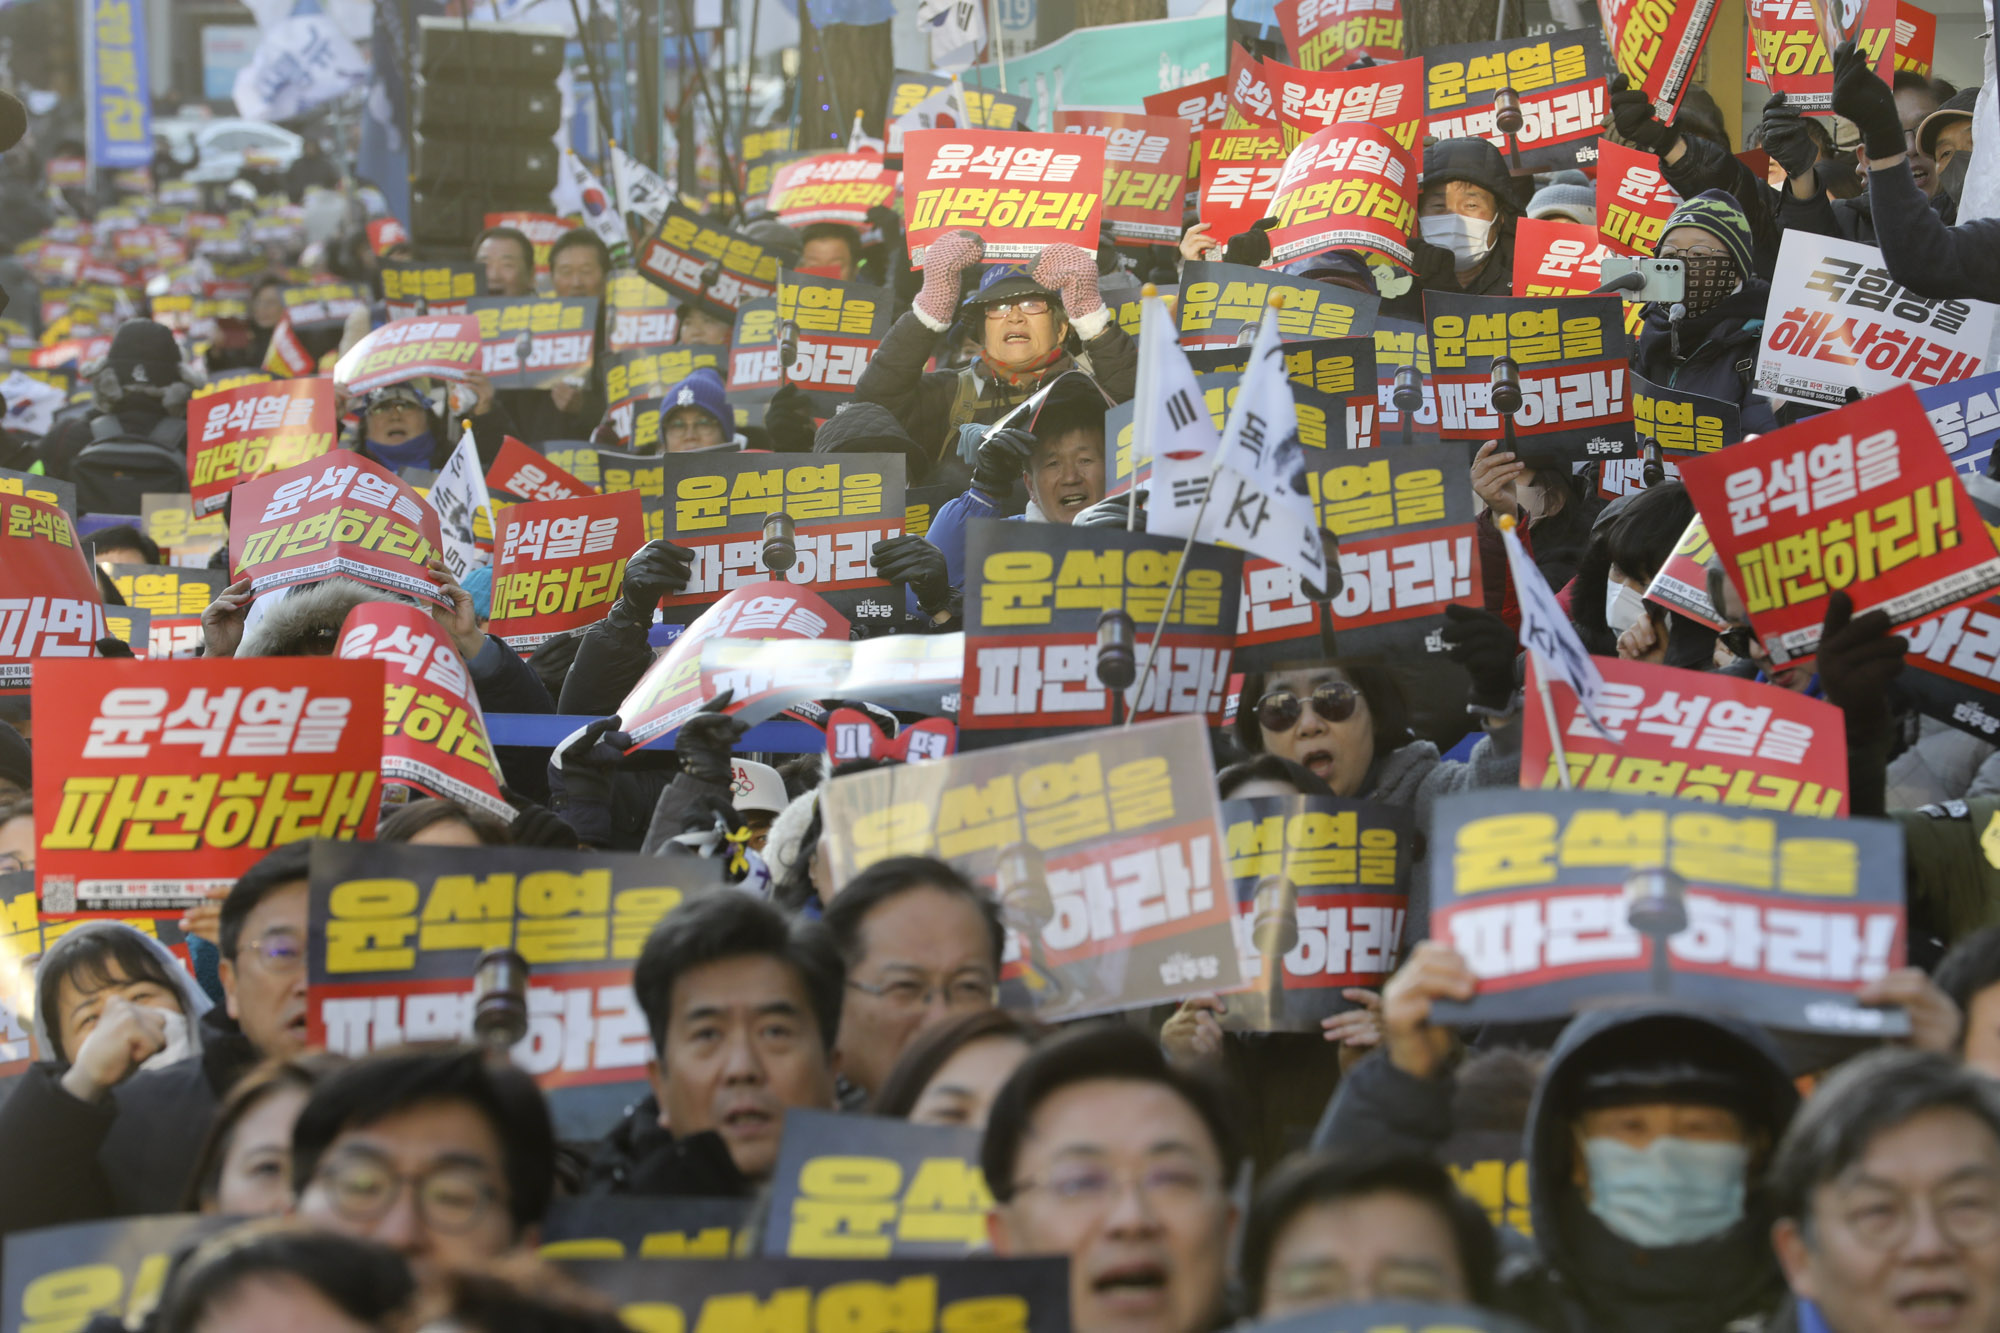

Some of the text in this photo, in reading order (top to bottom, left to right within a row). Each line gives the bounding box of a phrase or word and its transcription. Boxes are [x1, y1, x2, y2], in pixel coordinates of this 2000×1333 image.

[1282, 81, 1404, 125] 윤석열을
[1428, 42, 1587, 110] 윤석열을
[926, 143, 1081, 182] 윤석열을
[1208, 136, 1288, 161] 내란수
[1285, 137, 1406, 187] 윤석열을
[1575, 149, 1599, 163] 민주
[908, 188, 1098, 232] 파면하라!
[1264, 178, 1416, 238] 파면하라!
[660, 215, 783, 282] 윤석열을
[473, 302, 585, 338] 윤석열을
[1181, 281, 1355, 339] 윤석열을
[1433, 308, 1603, 368] 윤석열을
[1767, 307, 1982, 386] 해산하라!
[202, 394, 315, 442] 윤석열을
[1586, 440, 1624, 455] 민주당
[260, 464, 424, 525] 윤석열을
[675, 464, 882, 532] 윤석열을
[1725, 429, 1901, 536] 윤석열을
[234, 504, 442, 577] 파면하라!
[501, 515, 619, 565] 윤석열을
[1736, 476, 1959, 613] 파면하라!
[856, 602, 893, 619] 민주당
[981, 549, 1223, 627] 윤석열을
[82, 686, 352, 758] 윤석열을
[1567, 683, 1814, 765] 윤석열을
[41, 771, 377, 851] 파면하라!
[852, 752, 1175, 873] 윤석열을
[1453, 810, 1858, 895] 윤석열을
[325, 869, 683, 974] 윤석열을
